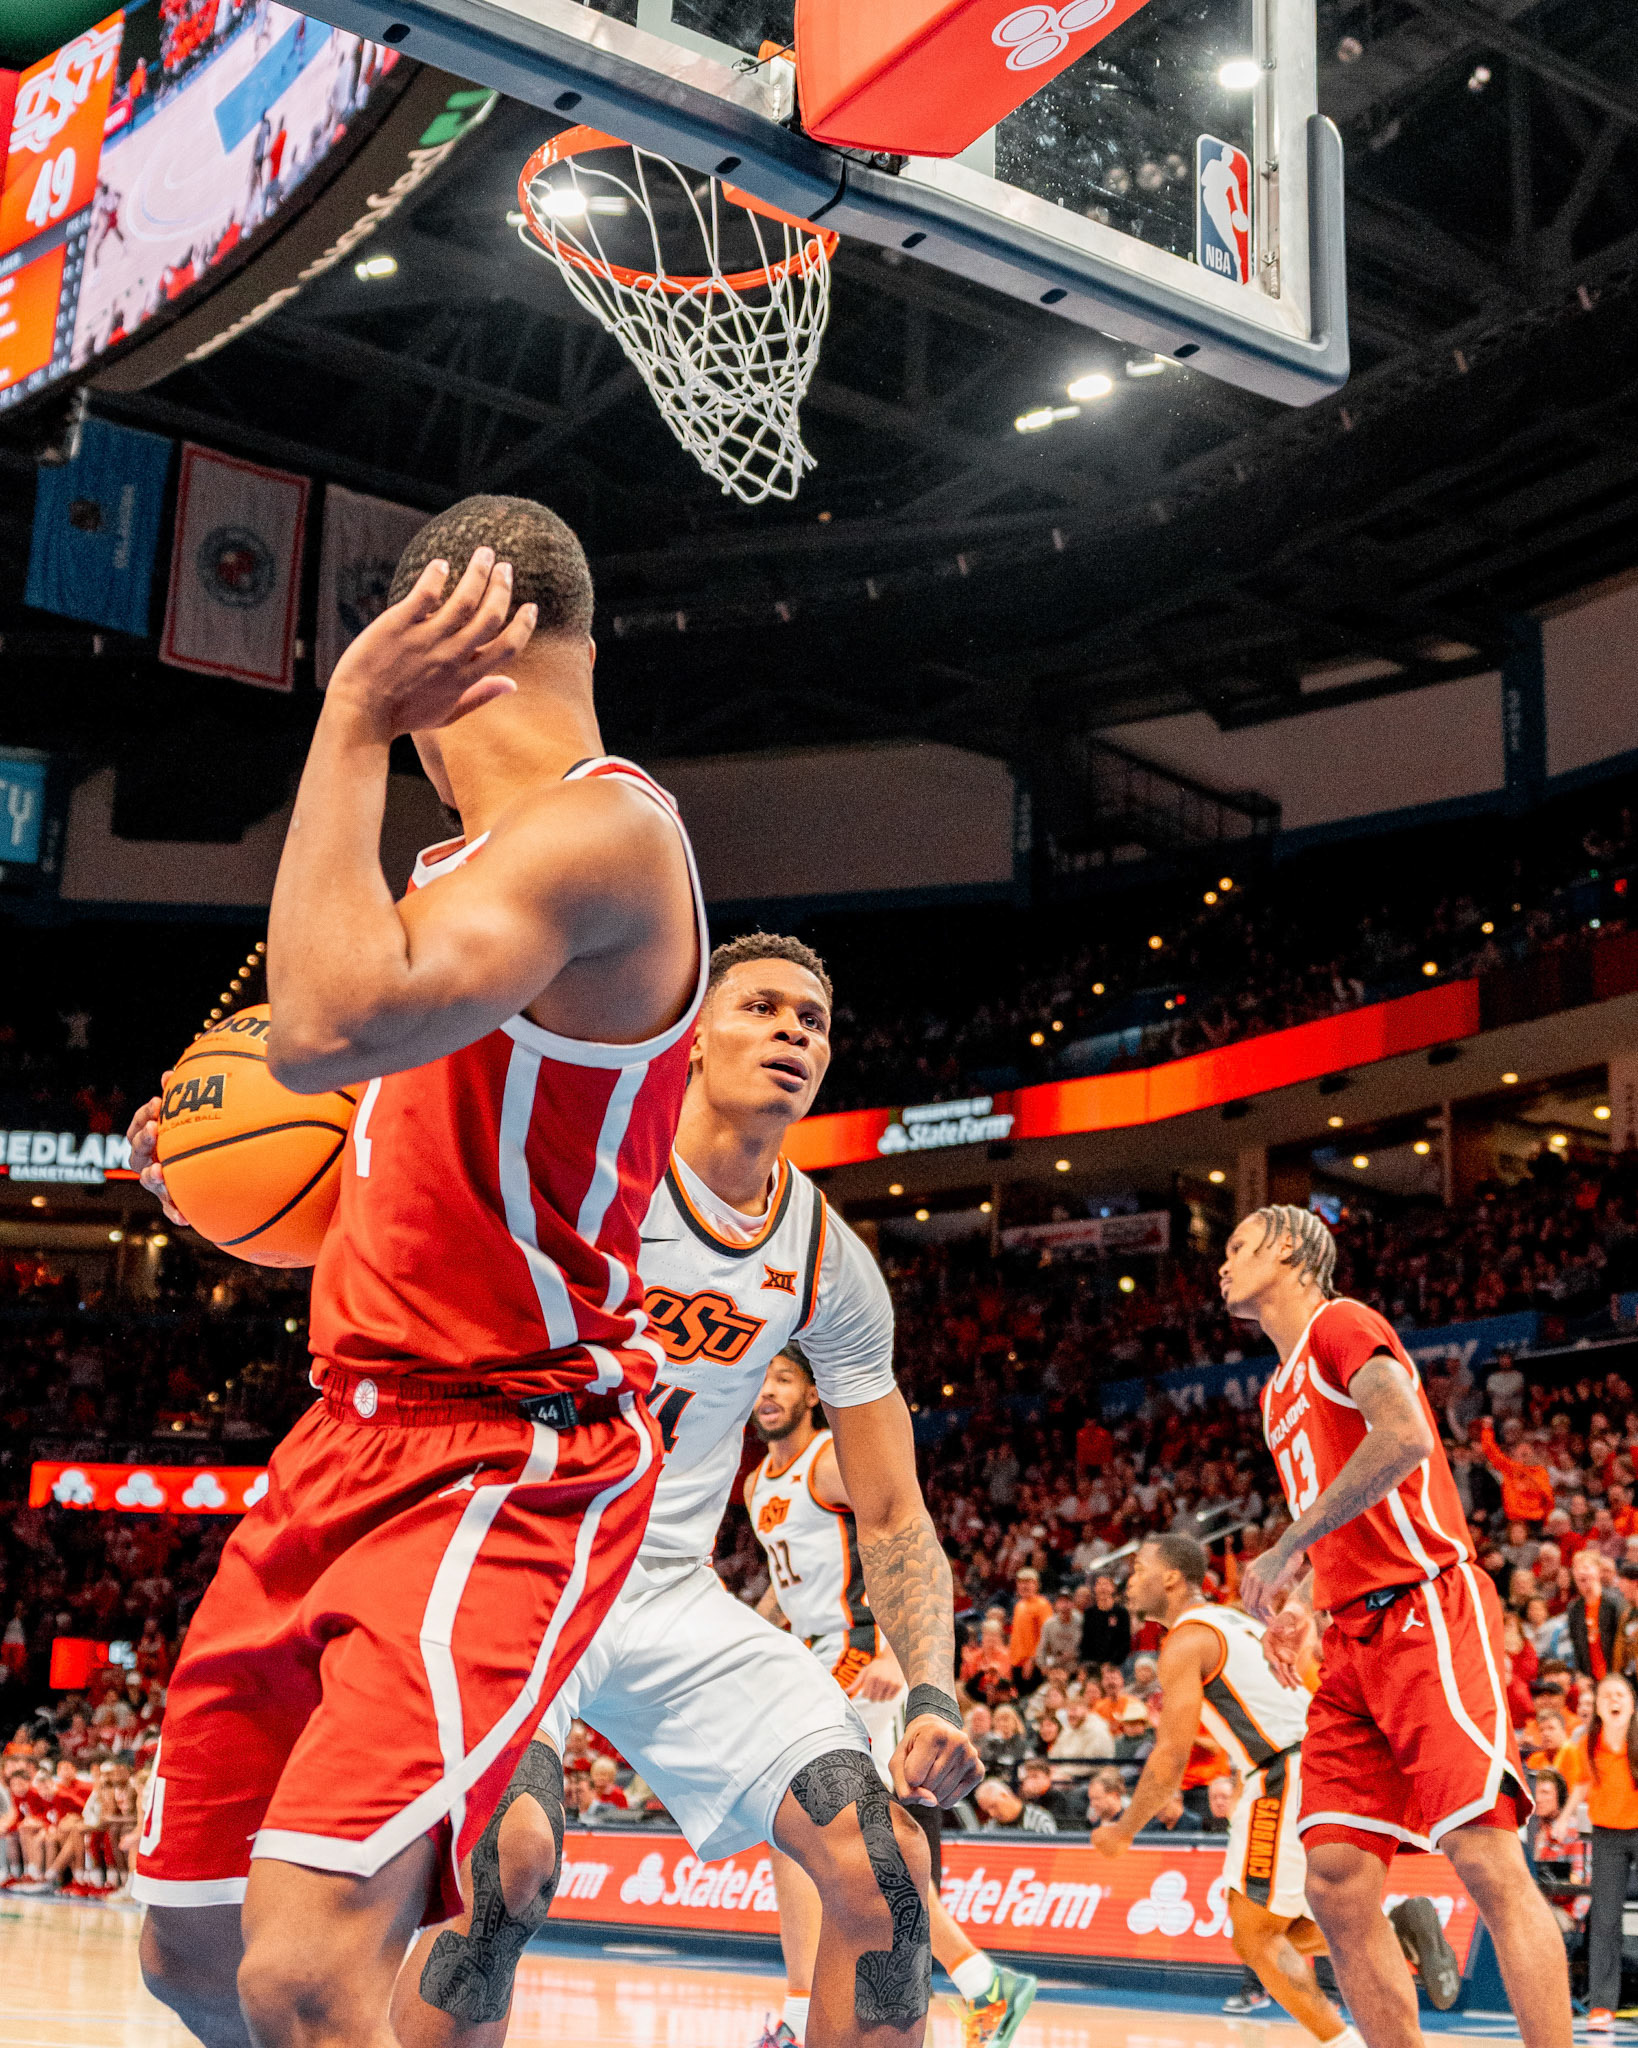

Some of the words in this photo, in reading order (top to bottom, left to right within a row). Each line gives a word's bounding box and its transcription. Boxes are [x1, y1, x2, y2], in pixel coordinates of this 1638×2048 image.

[26, 148, 76, 227] 49
[1205, 243, 1232, 275] NBA
[641, 1287, 767, 1366] OSU
[538, 1404, 558, 1421] 44
[1270, 1393, 1310, 1450] KLAHOMA
[1279, 1429, 1319, 1521] 13
[1248, 1797, 1280, 1879] COWBOYS
[662, 1855, 779, 1911] StateFa
[941, 1867, 1101, 1929] ateFarm
